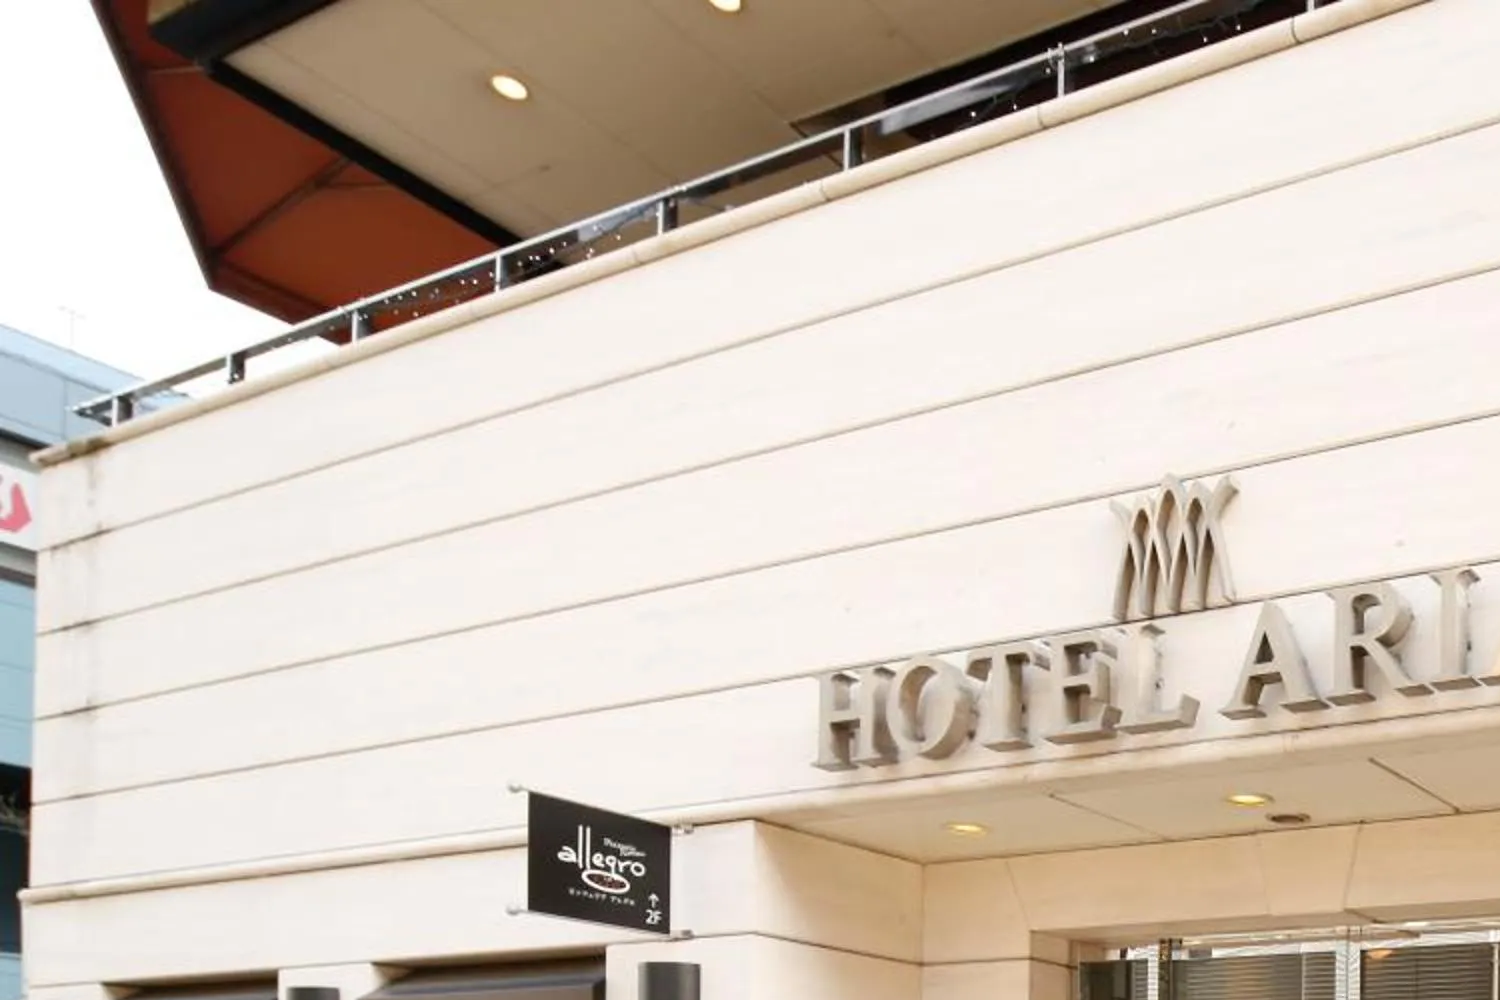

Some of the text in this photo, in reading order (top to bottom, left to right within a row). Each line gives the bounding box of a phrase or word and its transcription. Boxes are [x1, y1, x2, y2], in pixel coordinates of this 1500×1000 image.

[813, 621, 1198, 772] HOTEL
[557, 825, 646, 878] allegro
[645, 909, 662, 924] 2F
